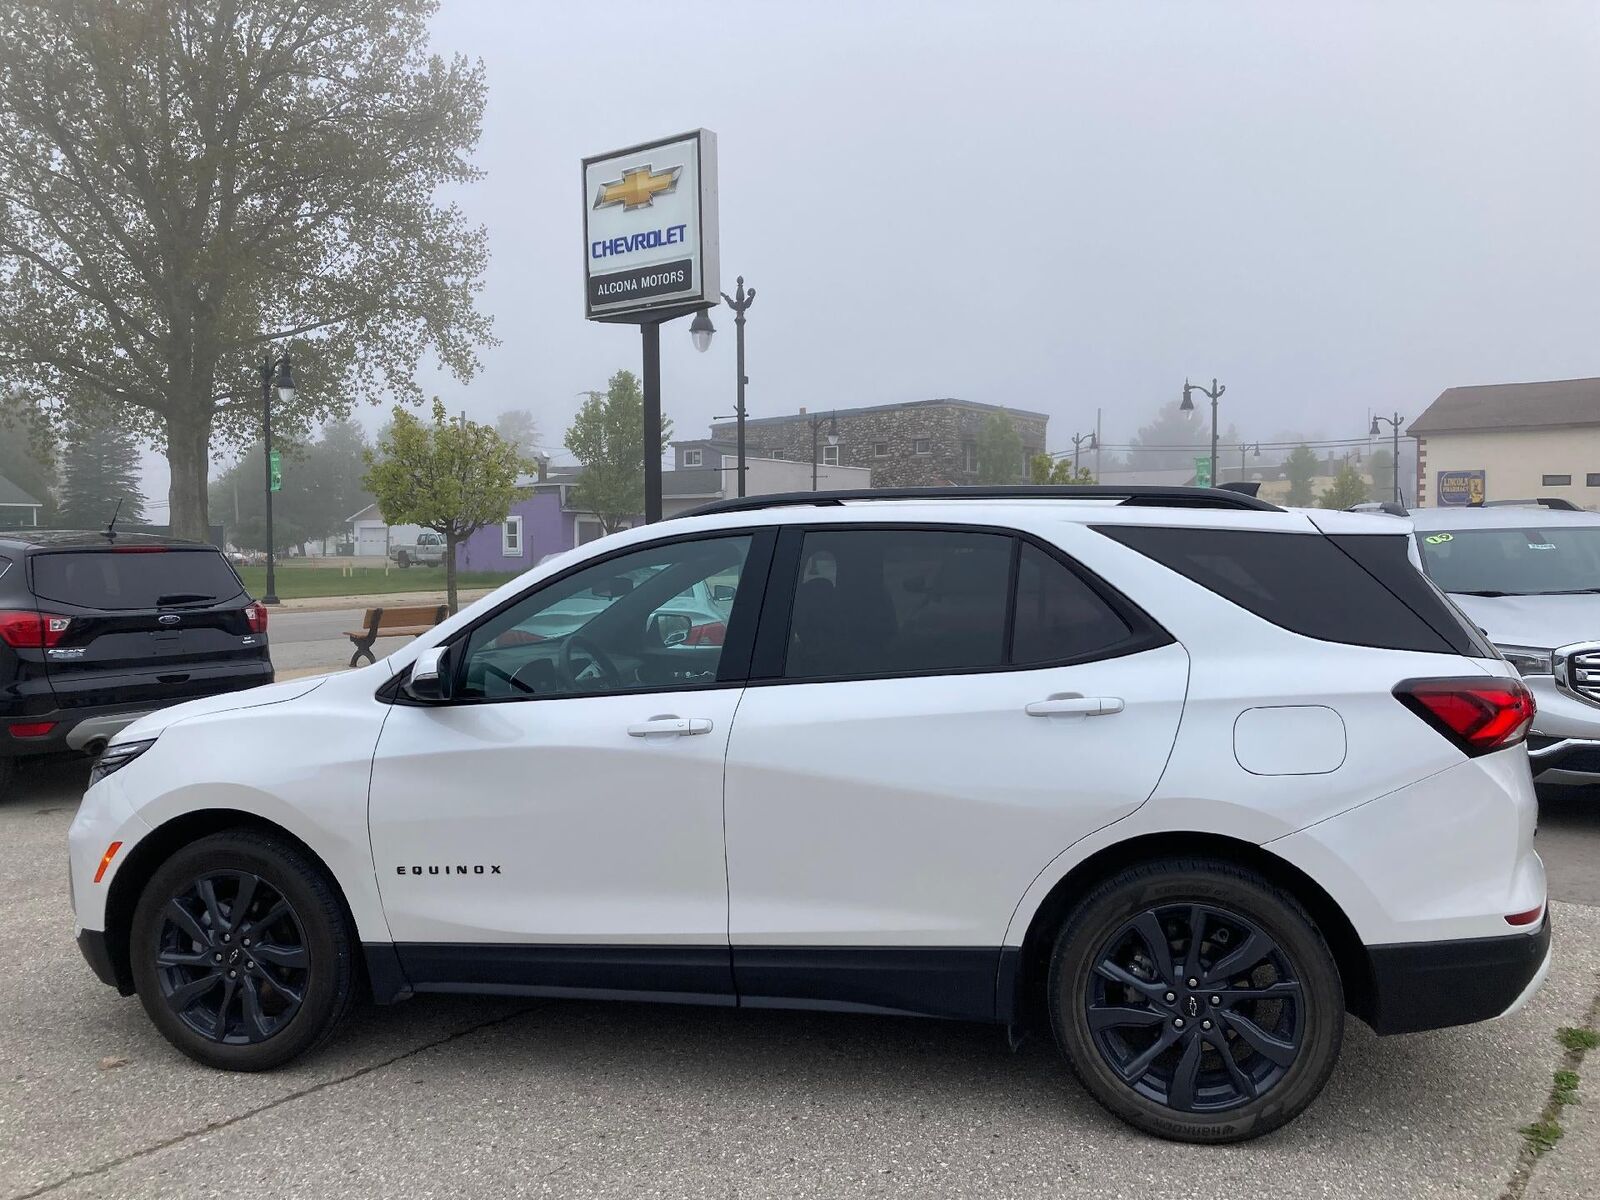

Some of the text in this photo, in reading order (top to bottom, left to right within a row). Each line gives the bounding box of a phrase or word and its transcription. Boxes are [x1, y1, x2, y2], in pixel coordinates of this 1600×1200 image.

[592, 223, 687, 259] CHEVROLET
[597, 270, 684, 296] ALCONA MOTORS
[396, 865, 501, 876] EQUINOX
